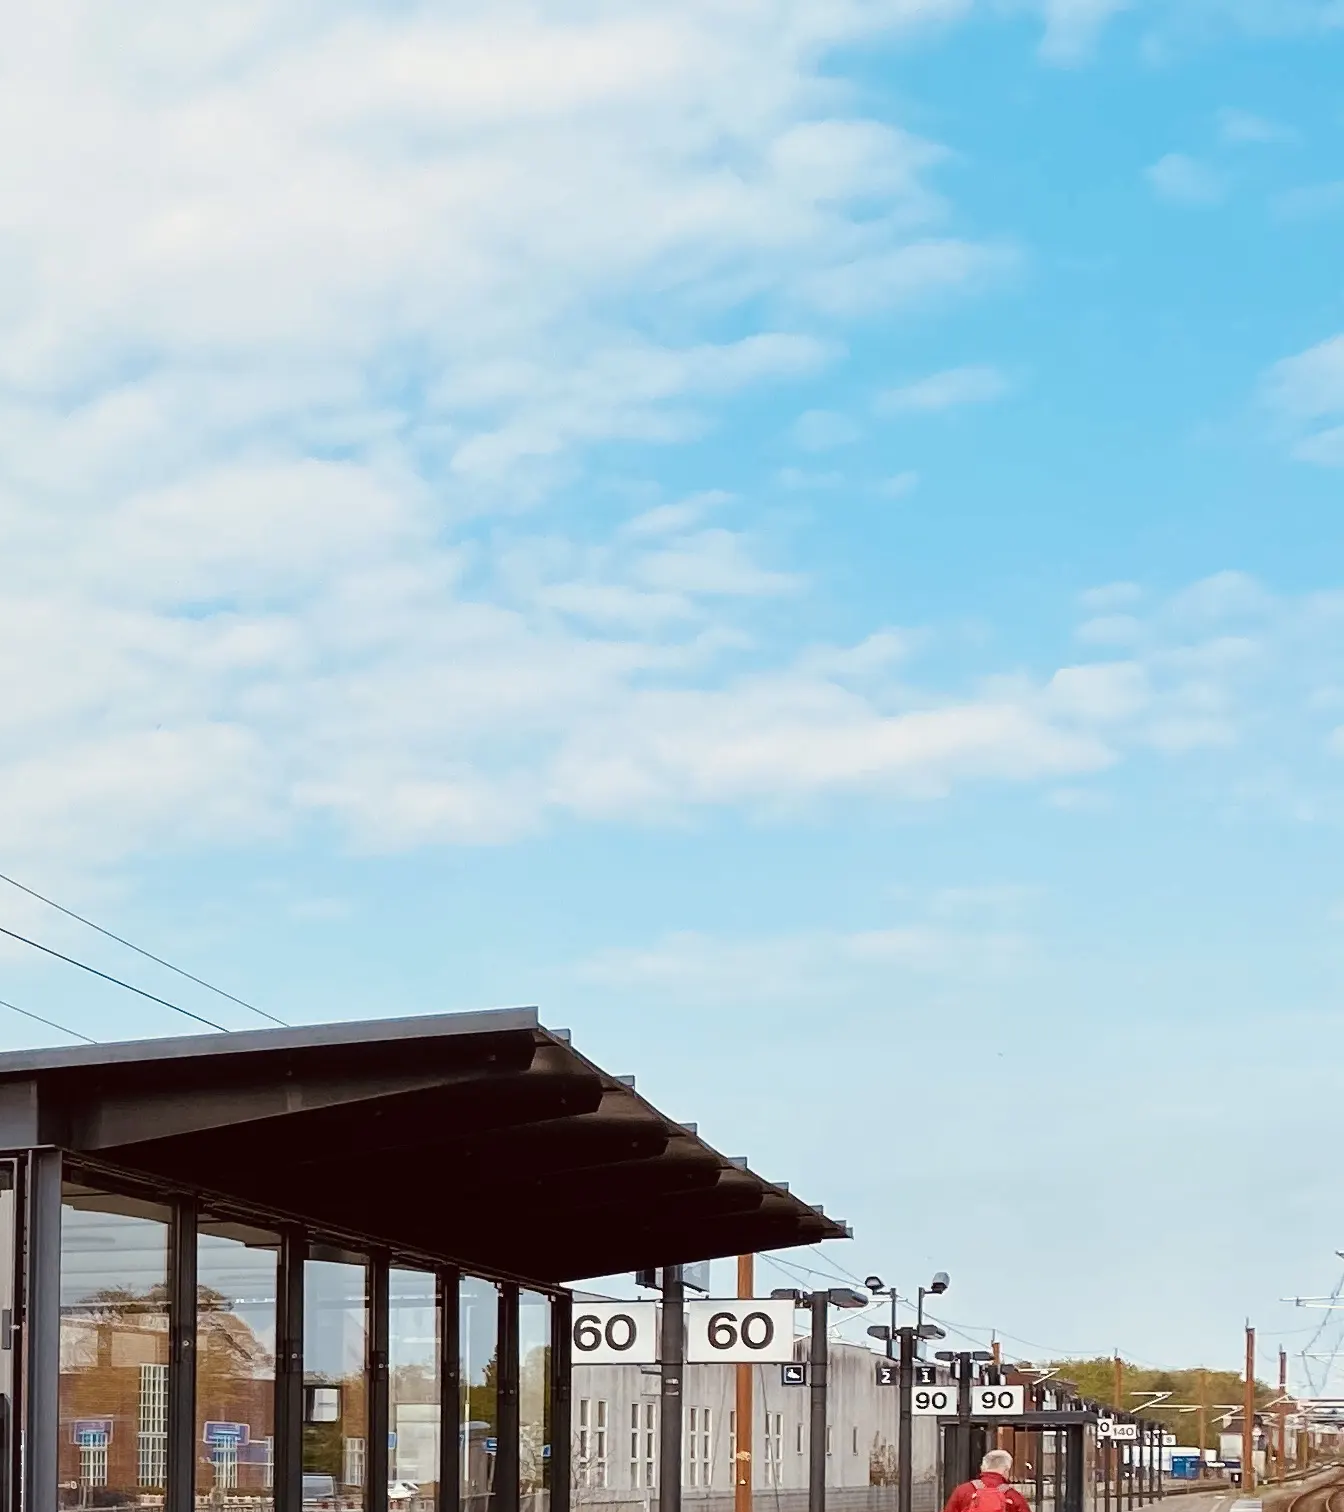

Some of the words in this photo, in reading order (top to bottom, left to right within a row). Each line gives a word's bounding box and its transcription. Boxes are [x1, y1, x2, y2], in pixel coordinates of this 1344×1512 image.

[573, 1313, 637, 1351] 60
[707, 1311, 774, 1350] 60
[881, 1371, 891, 1384] 2
[921, 1371, 931, 1383] 1
[915, 1391, 948, 1410] 90
[981, 1391, 1014, 1409] 90
[1113, 1427, 1134, 1437] 140
